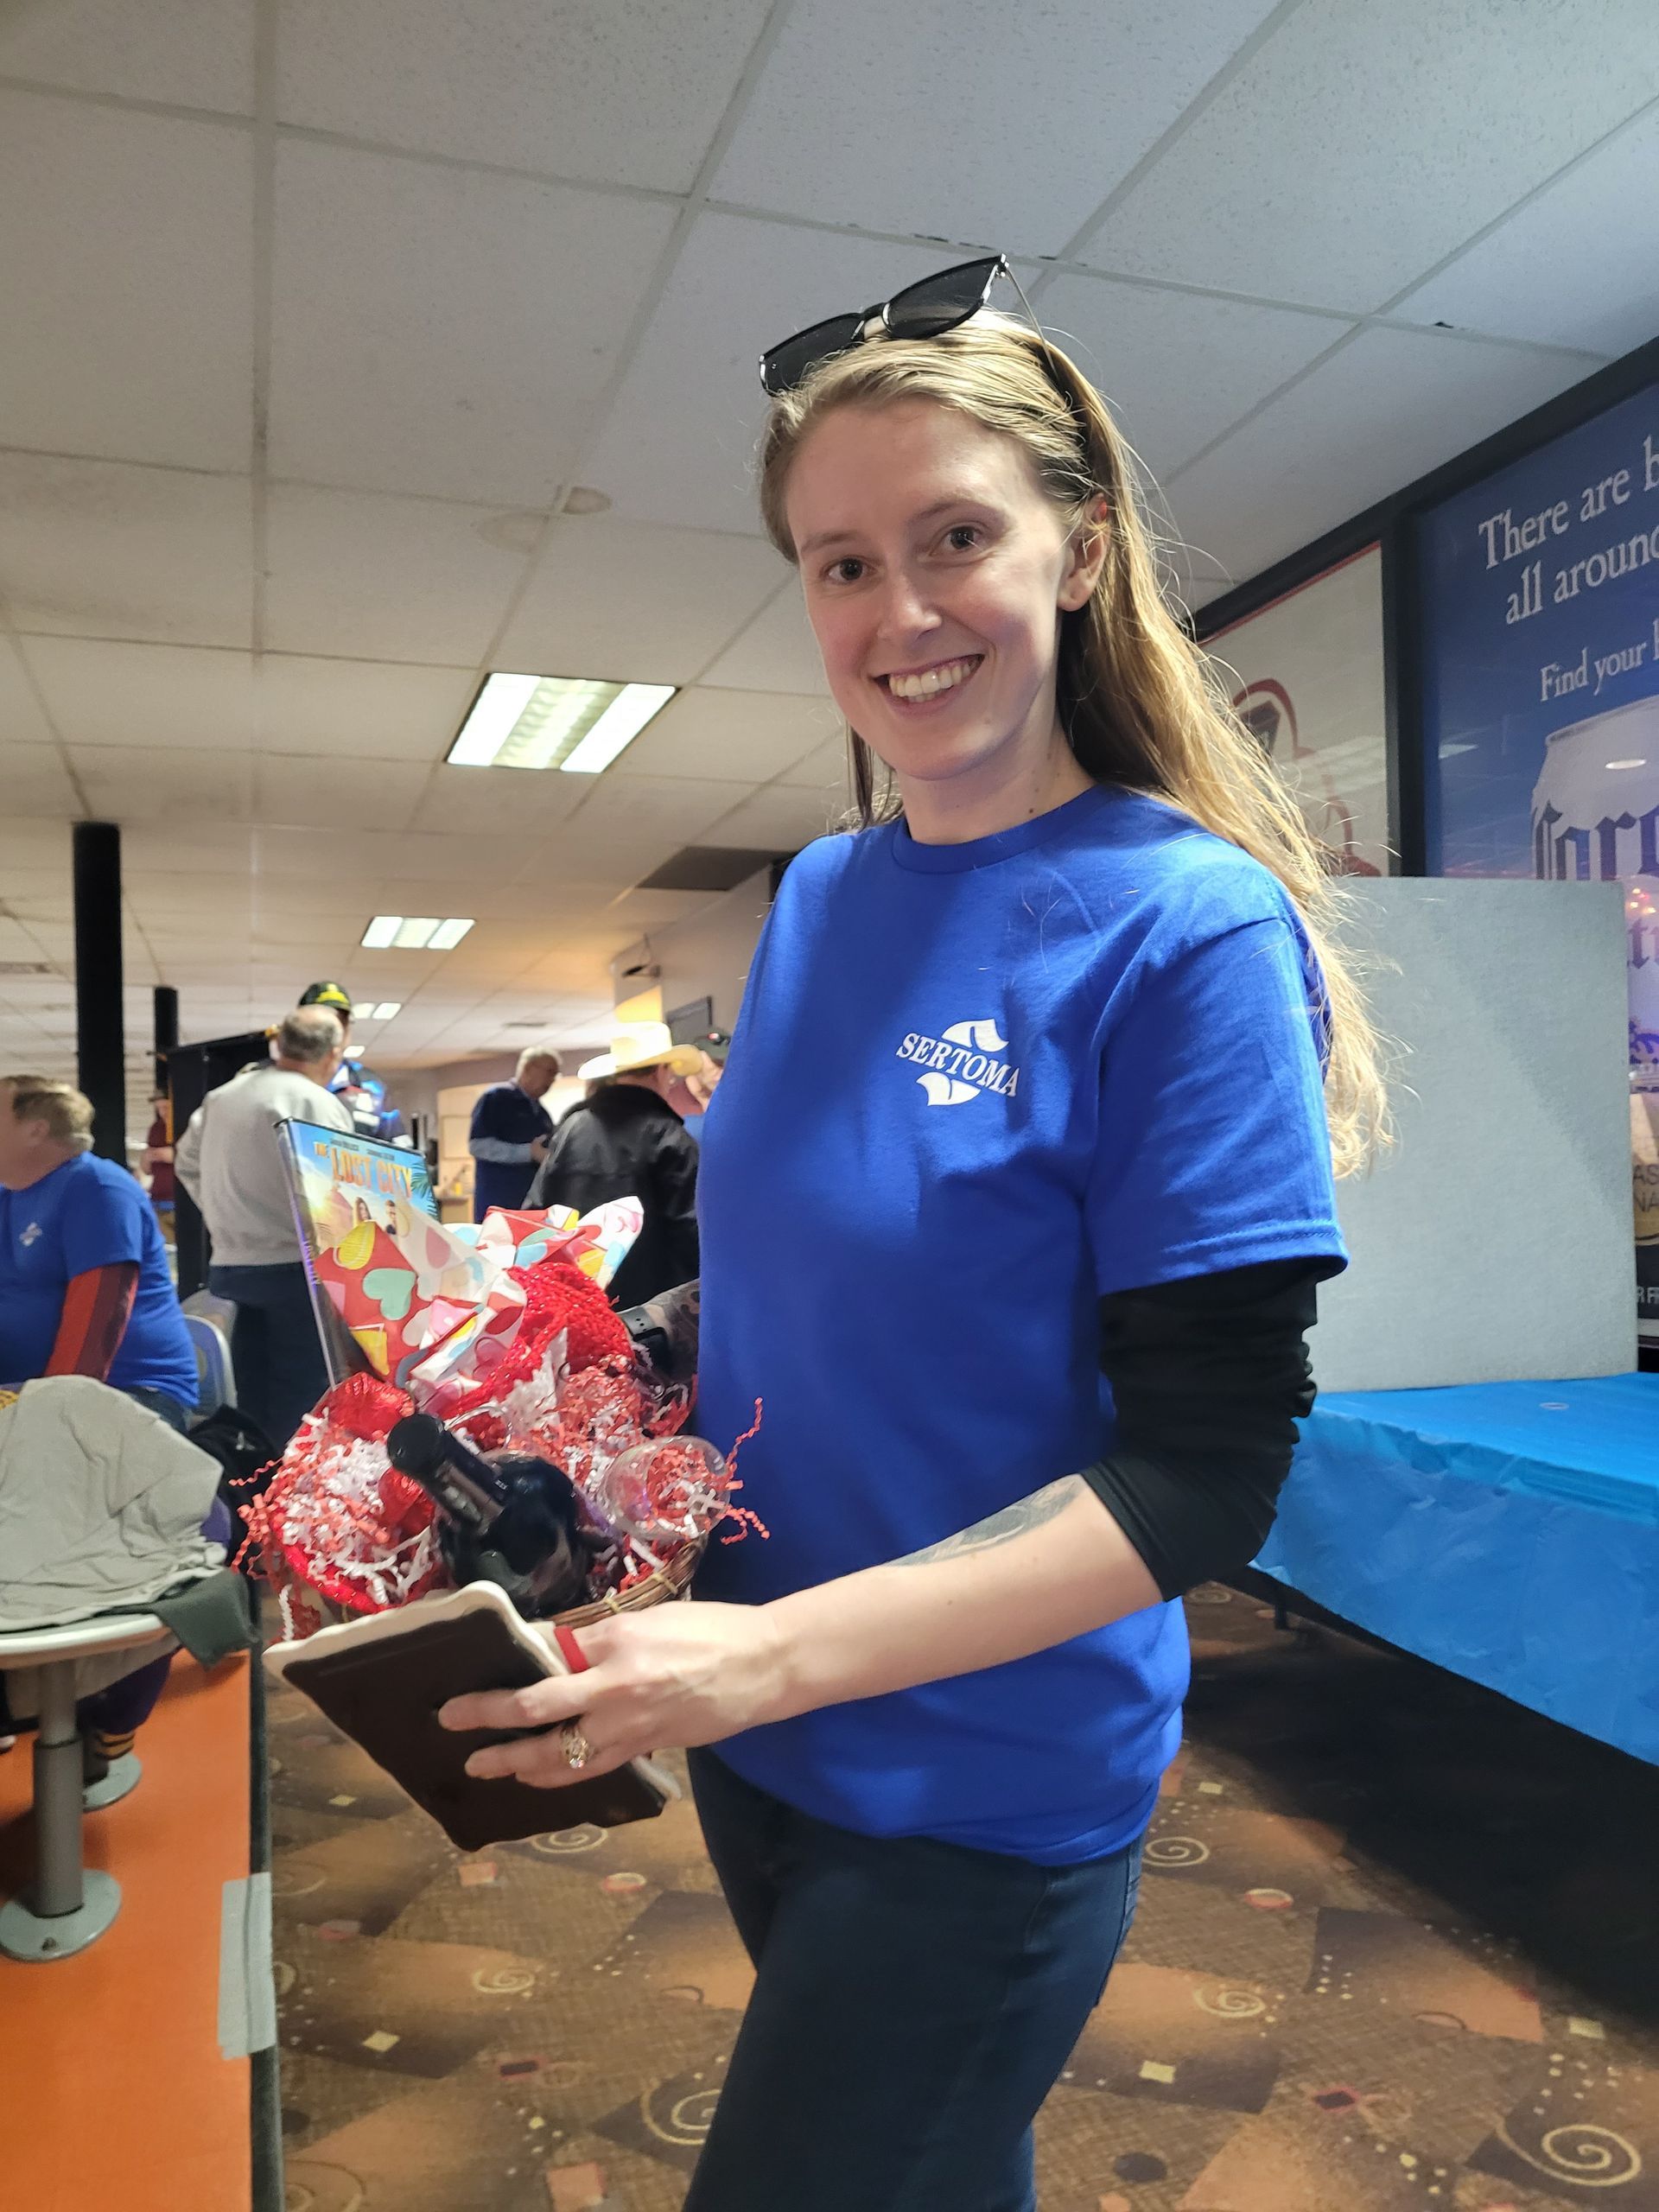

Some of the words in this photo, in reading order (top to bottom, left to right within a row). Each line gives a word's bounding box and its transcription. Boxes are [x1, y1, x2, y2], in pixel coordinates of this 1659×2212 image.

[1478, 509, 1569, 570] There
[1580, 469, 1631, 522] are
[1506, 560, 1543, 624] all
[1540, 647, 1590, 702] Find
[1593, 642, 1648, 696] your
[895, 1033, 1020, 1097] SERTOMA
[331, 1147, 372, 1189] LOST
[377, 1160, 412, 1198] CITY
